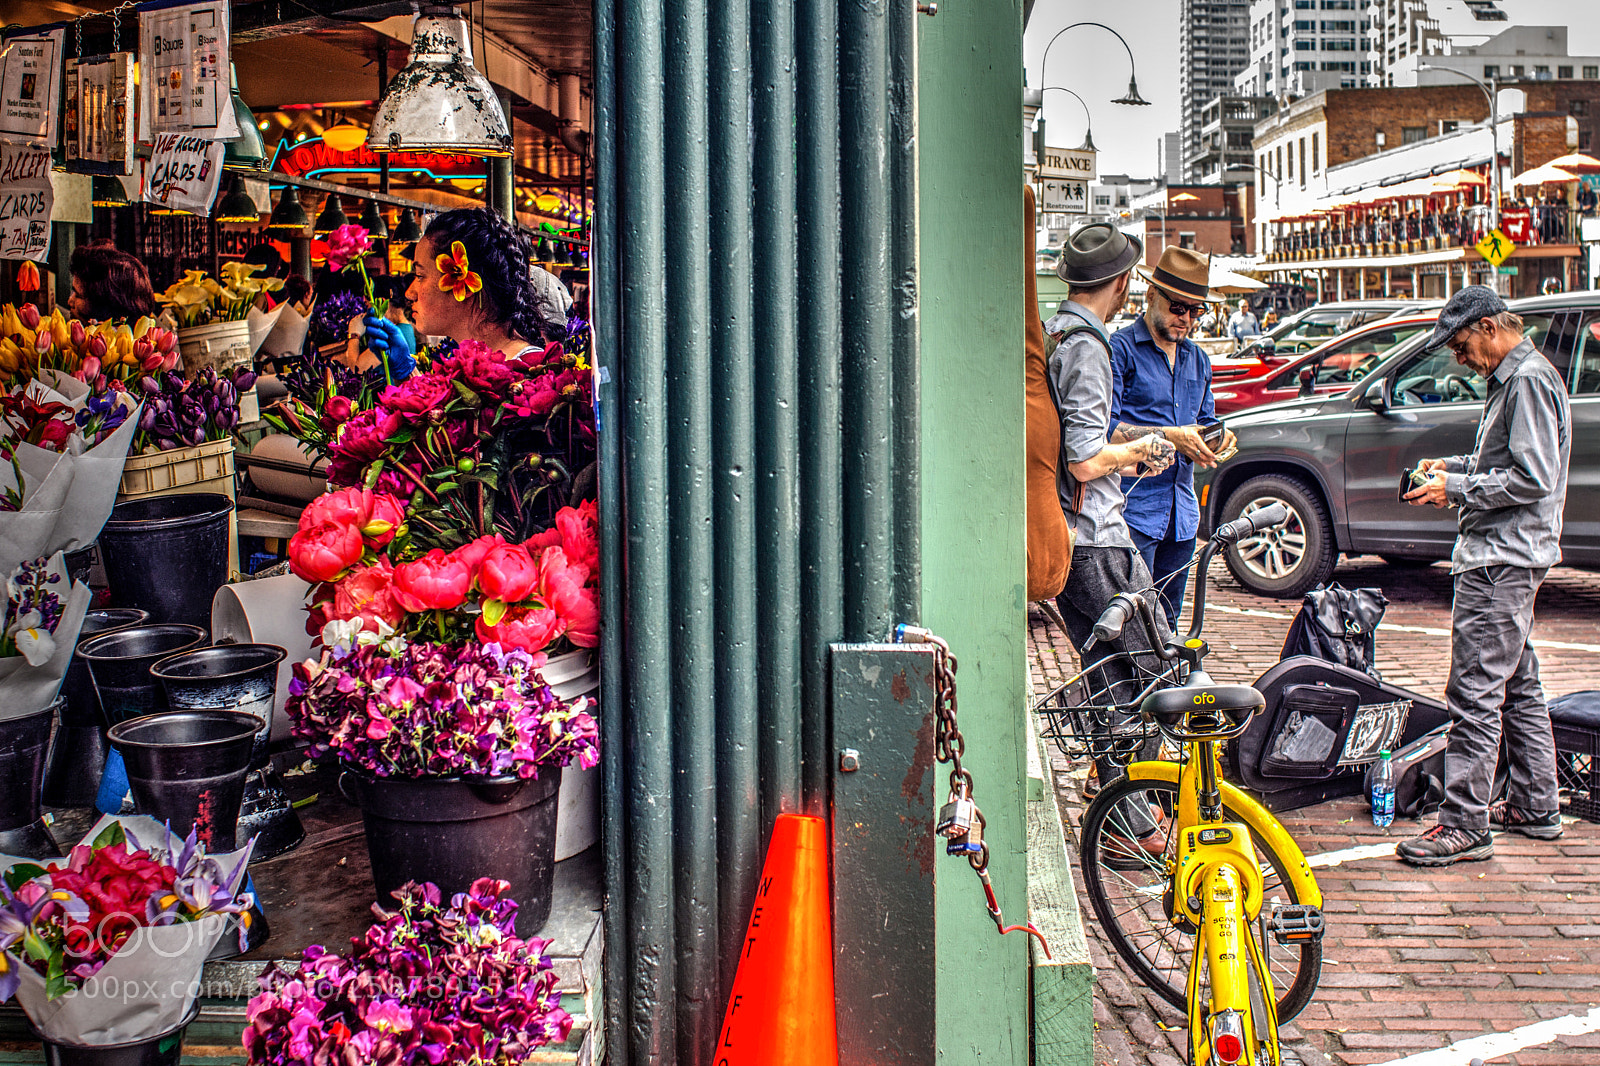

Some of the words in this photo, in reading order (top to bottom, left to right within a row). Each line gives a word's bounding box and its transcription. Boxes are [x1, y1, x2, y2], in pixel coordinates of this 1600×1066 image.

[162, 38, 184, 54] Square
[155, 134, 180, 154] WE
[175, 136, 214, 157] ACCEPT
[1, 152, 50, 184] ACCEPT
[280, 142, 376, 177] LOWER
[1046, 155, 1091, 171] TRANCE
[151, 161, 196, 189] CARDS
[0, 191, 45, 220] CARDS
[1046, 202, 1083, 210] Restrooms
[1193, 691, 1216, 705] ofo
[747, 877, 773, 958] WET
[1213, 916, 1236, 924] SCAN
